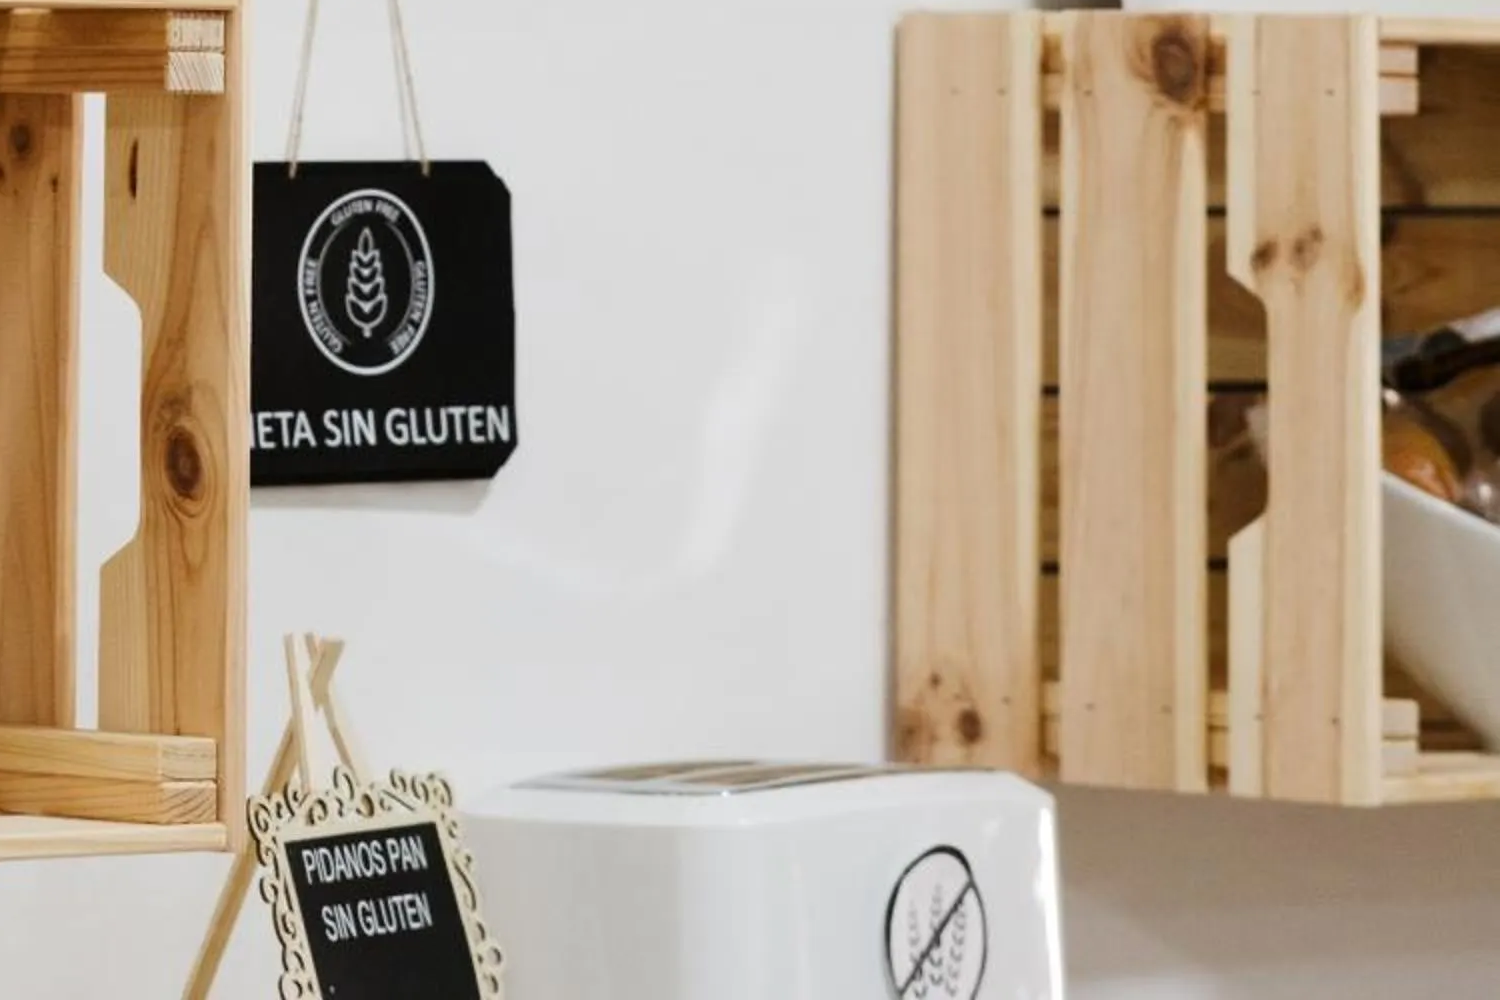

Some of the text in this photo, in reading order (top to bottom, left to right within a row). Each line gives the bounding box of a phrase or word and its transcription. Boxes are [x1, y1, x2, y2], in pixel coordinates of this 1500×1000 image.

[331, 199, 400, 227] GLUTEN FREE
[322, 408, 377, 447] SIN
[384, 404, 510, 446] GLUTEN
[302, 835, 428, 885] PIDANOS PAN
[321, 893, 433, 942] SIN GLUTEN
